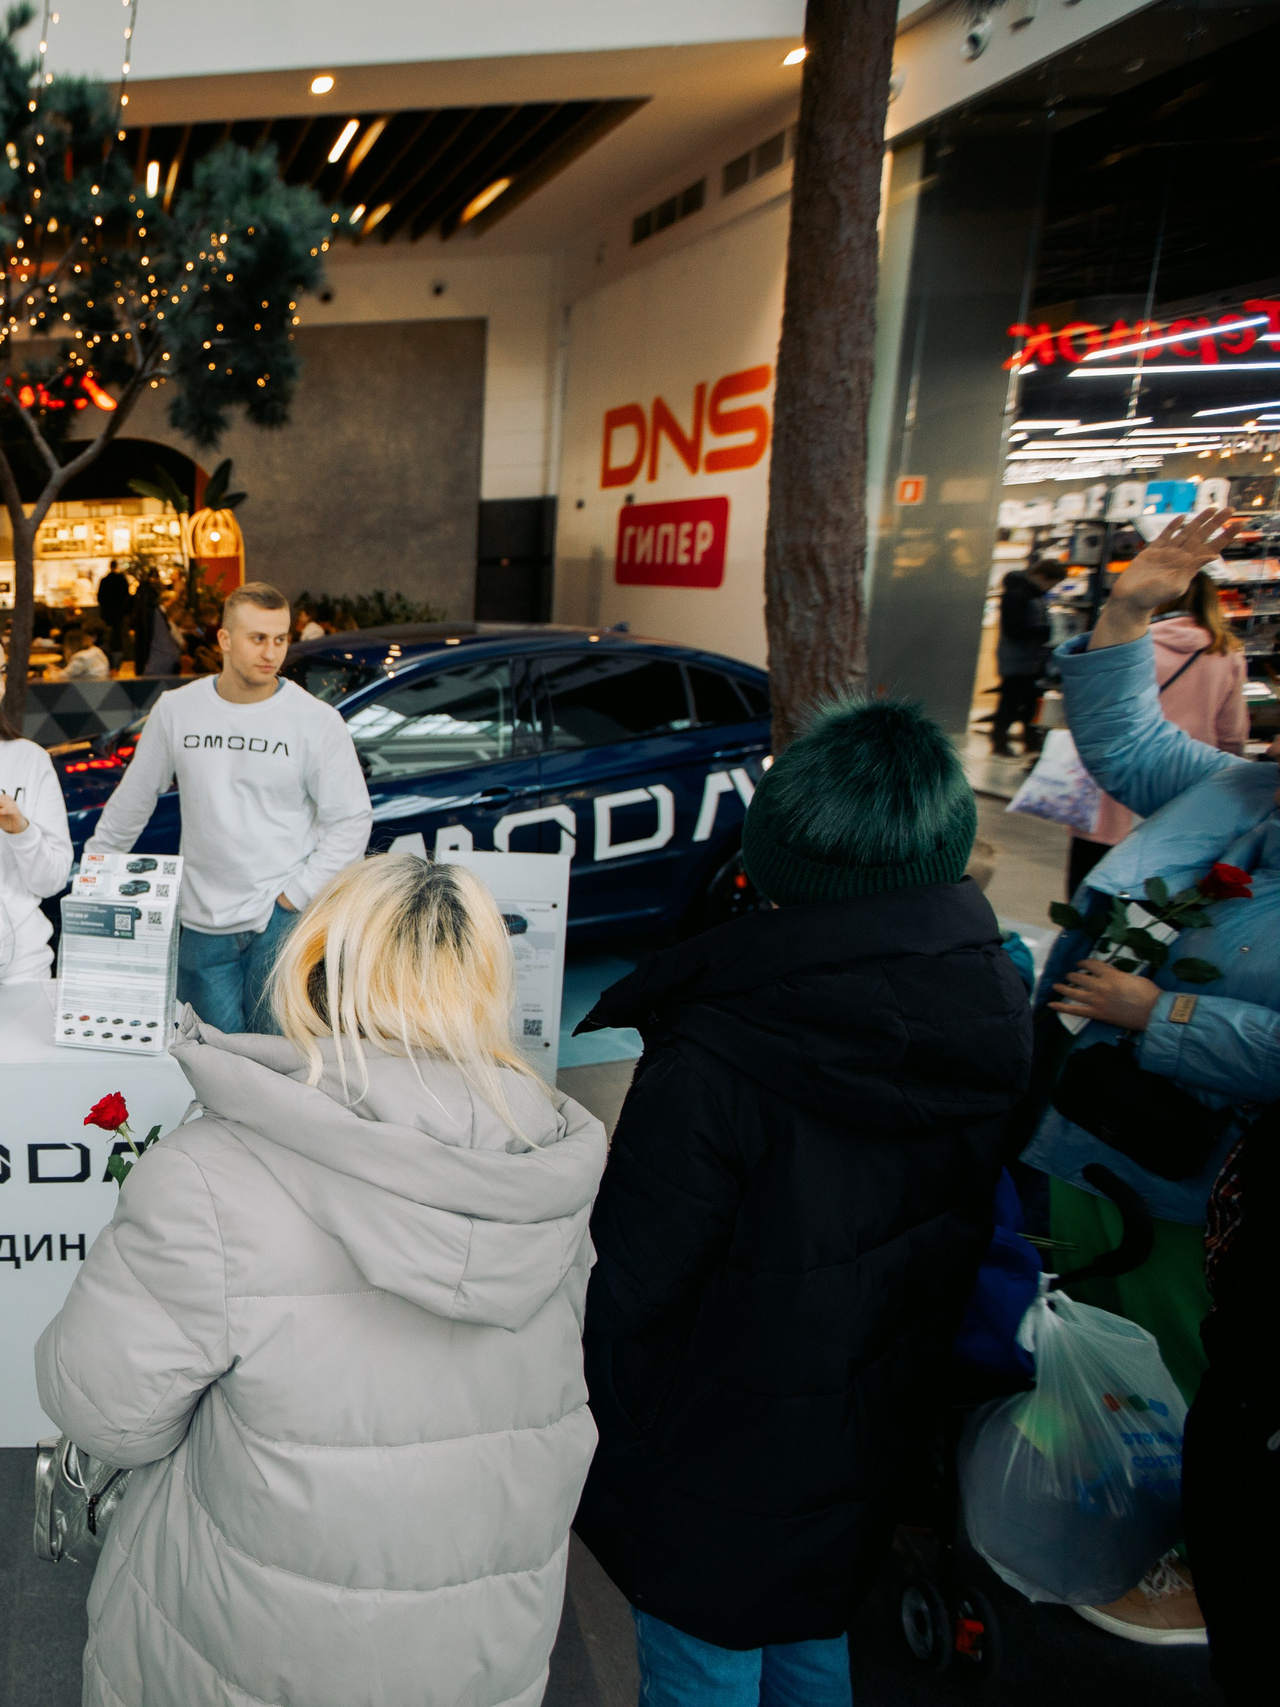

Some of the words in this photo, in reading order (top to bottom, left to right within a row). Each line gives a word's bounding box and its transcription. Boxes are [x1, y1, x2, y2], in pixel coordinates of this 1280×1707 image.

[600, 364, 772, 490] DNS
[622, 520, 715, 566] ГИПЕР
[183, 734, 290, 757] OMODA
